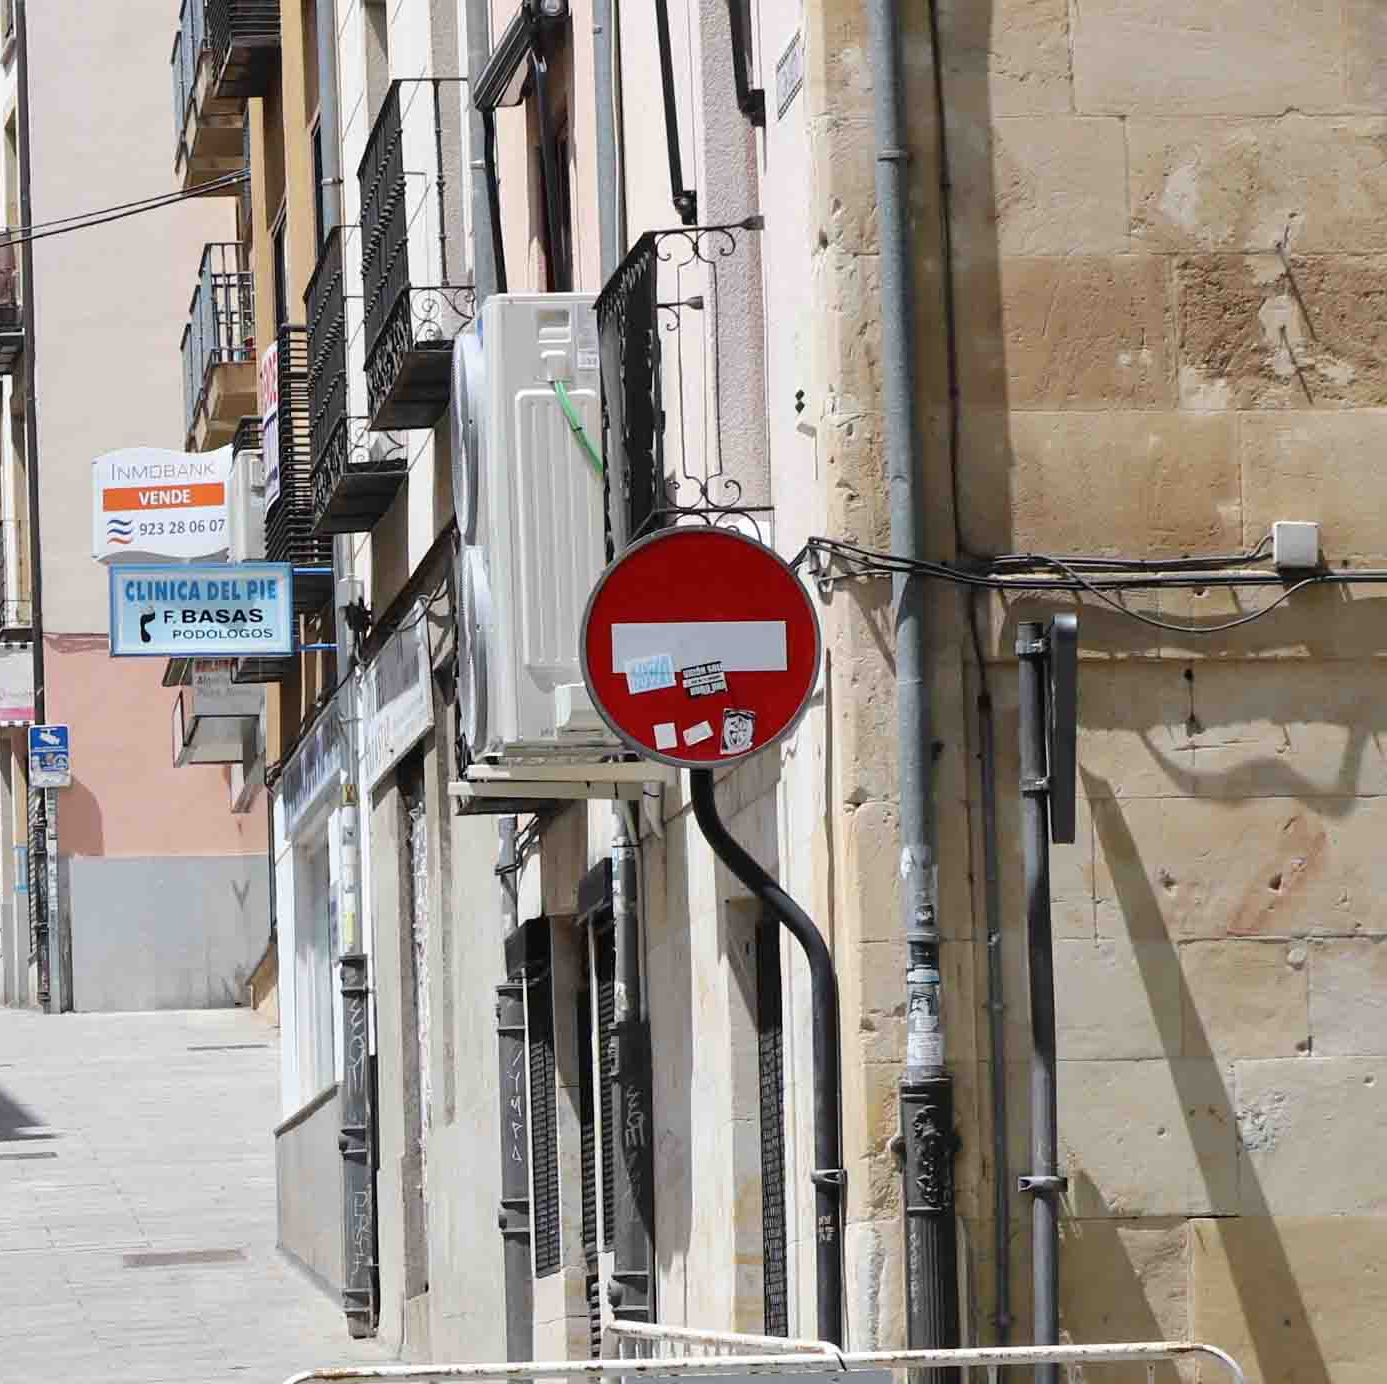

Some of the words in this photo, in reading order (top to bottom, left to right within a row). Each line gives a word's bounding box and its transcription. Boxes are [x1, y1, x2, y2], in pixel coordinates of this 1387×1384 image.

[138, 489, 192, 505] VENDE
[139, 521, 165, 535] 923
[169, 521, 186, 535] 28
[189, 520, 205, 533] 06
[209, 519, 226, 533] 07
[207, 580, 241, 601] DEL
[246, 579, 277, 600] PIE
[163, 610, 177, 624] F.
[182, 609, 263, 623] BASAS
